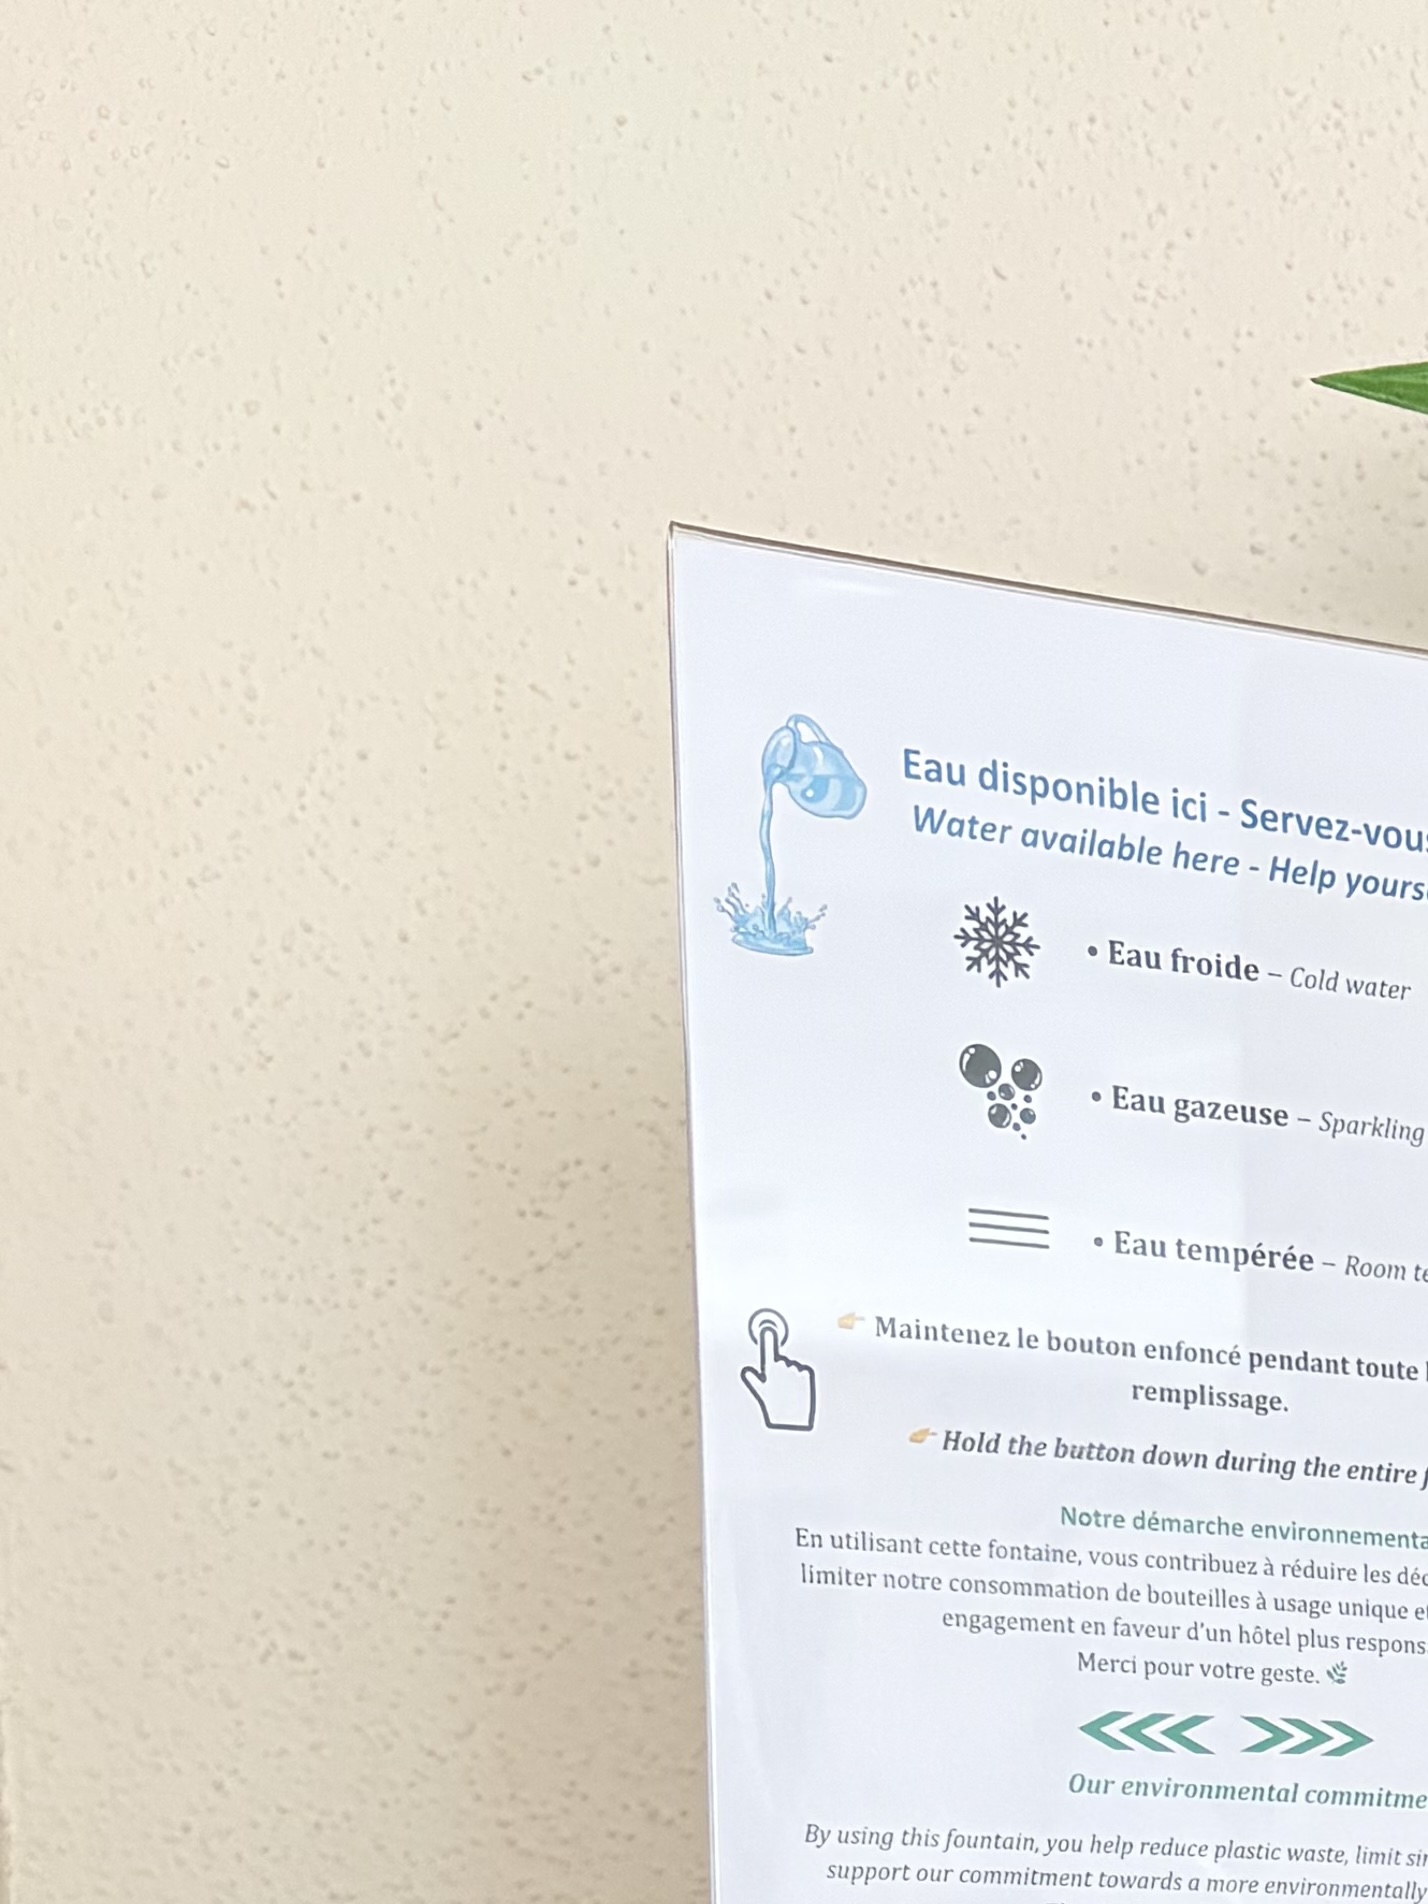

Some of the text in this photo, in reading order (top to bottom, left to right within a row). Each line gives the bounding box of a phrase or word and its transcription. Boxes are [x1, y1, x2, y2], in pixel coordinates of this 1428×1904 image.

[903, 747, 966, 788] Eau
[977, 758, 1161, 816] disponible
[1171, 786, 1207, 824] ici
[913, 804, 1013, 845] Water
[1020, 827, 1163, 866] available
[1172, 840, 1241, 877] here
[1268, 855, 1337, 895] Help
[1108, 939, 1163, 971] Eau
[1170, 946, 1260, 983] froide
[1289, 966, 1340, 993] Cold
[1345, 977, 1412, 1001] water
[1111, 1084, 1166, 1115] Eau
[1173, 1097, 1290, 1128] gazeuse
[1318, 1110, 1426, 1148] Sparkling
[1114, 1229, 1167, 1259] Eau
[1175, 1238, 1315, 1273] tempérée
[1344, 1254, 1407, 1281] Room
[875, 1315, 1011, 1348] Maintenez
[1017, 1326, 1040, 1350] le
[1046, 1329, 1137, 1359] bouton
[1143, 1340, 1242, 1367] enfoncé
[1248, 1349, 1351, 1376] pendant
[1355, 1357, 1420, 1382] toute
[1131, 1383, 1289, 1417] remplissage.
[942, 1429, 1002, 1455] Hold
[1007, 1434, 1048, 1458] the
[1053, 1436, 1136, 1465] button
[1141, 1443, 1209, 1470] down
[1214, 1448, 1297, 1481] during
[1303, 1455, 1342, 1479] the
[1346, 1461, 1418, 1485] entire
[1060, 1505, 1126, 1529] Notre
[1132, 1509, 1245, 1538] démarche
[795, 1526, 824, 1549] En
[829, 1530, 923, 1555] utilisant
[928, 1539, 982, 1558] cette
[988, 1538, 1083, 1567] fontaine,
[1088, 1550, 1139, 1568] vous
[1144, 1552, 1258, 1576] contribuez
[1262, 1556, 1275, 1577] à
[1281, 1558, 1358, 1582] réduire
[1363, 1562, 1392, 1585] les
[800, 1562, 878, 1588] limiter
[882, 1572, 943, 1592] notre
[948, 1577, 1109, 1602] consommation
[1115, 1581, 1142, 1603] de
[1146, 1583, 1251, 1610] bouteilles
[1255, 1590, 1268, 1611] à
[1273, 1597, 1332, 1620] usage
[1337, 1598, 1409, 1624] unique
[942, 1612, 1076, 1636] engagement
[1080, 1620, 1106, 1636] en
[1112, 1615, 1181, 1640] faveur
[1238, 1623, 1291, 1647] hôtel
[1296, 1627, 1340, 1653] plus
[1077, 1651, 1320, 1687] Merci pour votre geste.
[1068, 1773, 1116, 1795] Our
[1120, 1777, 1300, 1804] environmental
[804, 1823, 832, 1849] By
[837, 1826, 894, 1852] using
[901, 1826, 940, 1848] this
[942, 1827, 1040, 1854] fountain,
[1042, 1837, 1084, 1857] you
[1089, 1833, 1134, 1861] help
[1139, 1836, 1209, 1858] reduce
[1213, 1839, 1282, 1864] plastic
[1286, 1847, 1349, 1866] waste,
[1355, 1844, 1402, 1866] limit
[826, 1864, 911, 1886] support
[915, 1867, 955, 1883] our
[958, 1868, 1094, 1888] commitment
[1098, 1870, 1183, 1891] towards
[1187, 1877, 1201, 1892] a
[1206, 1878, 1260, 1894] more
